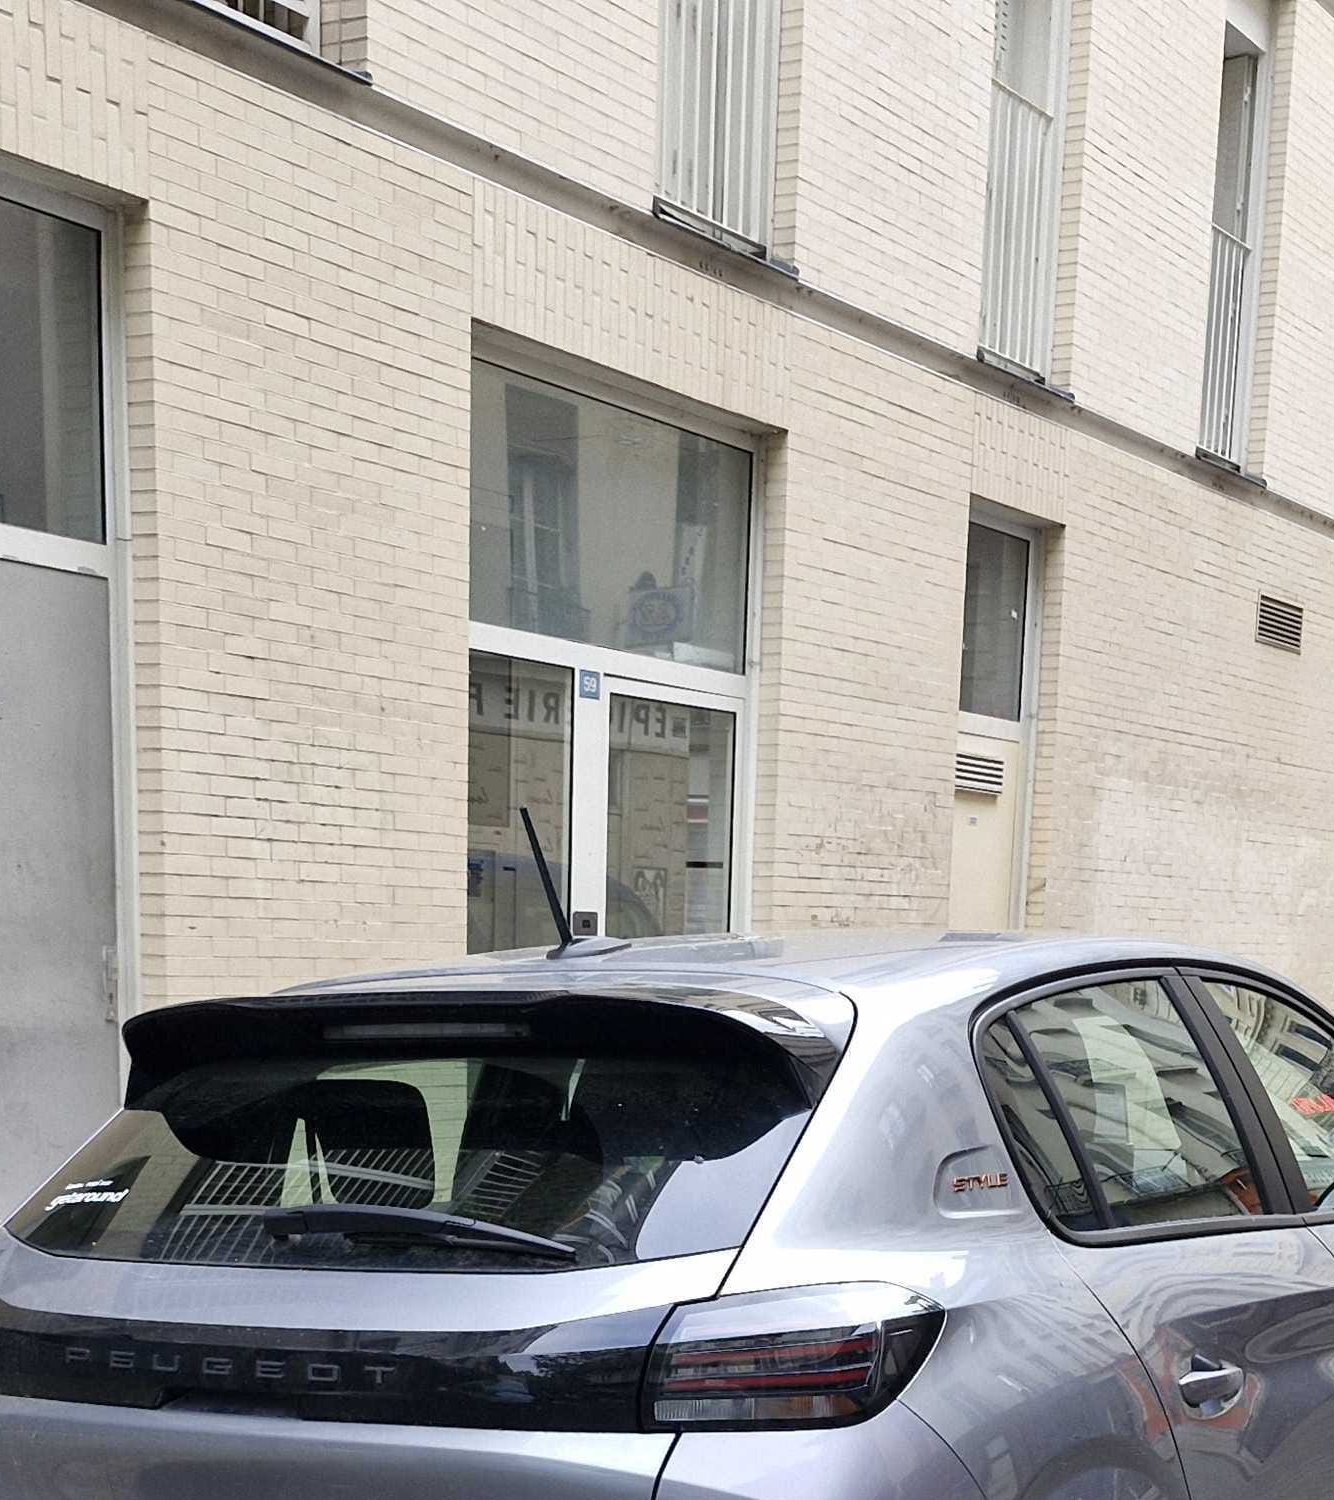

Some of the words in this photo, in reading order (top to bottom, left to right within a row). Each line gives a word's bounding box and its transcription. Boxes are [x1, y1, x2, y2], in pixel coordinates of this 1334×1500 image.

[953, 1173, 1008, 1192] STYLE
[44, 1188, 129, 1211] getaround
[65, 1346, 397, 1384] PEUGEOT
